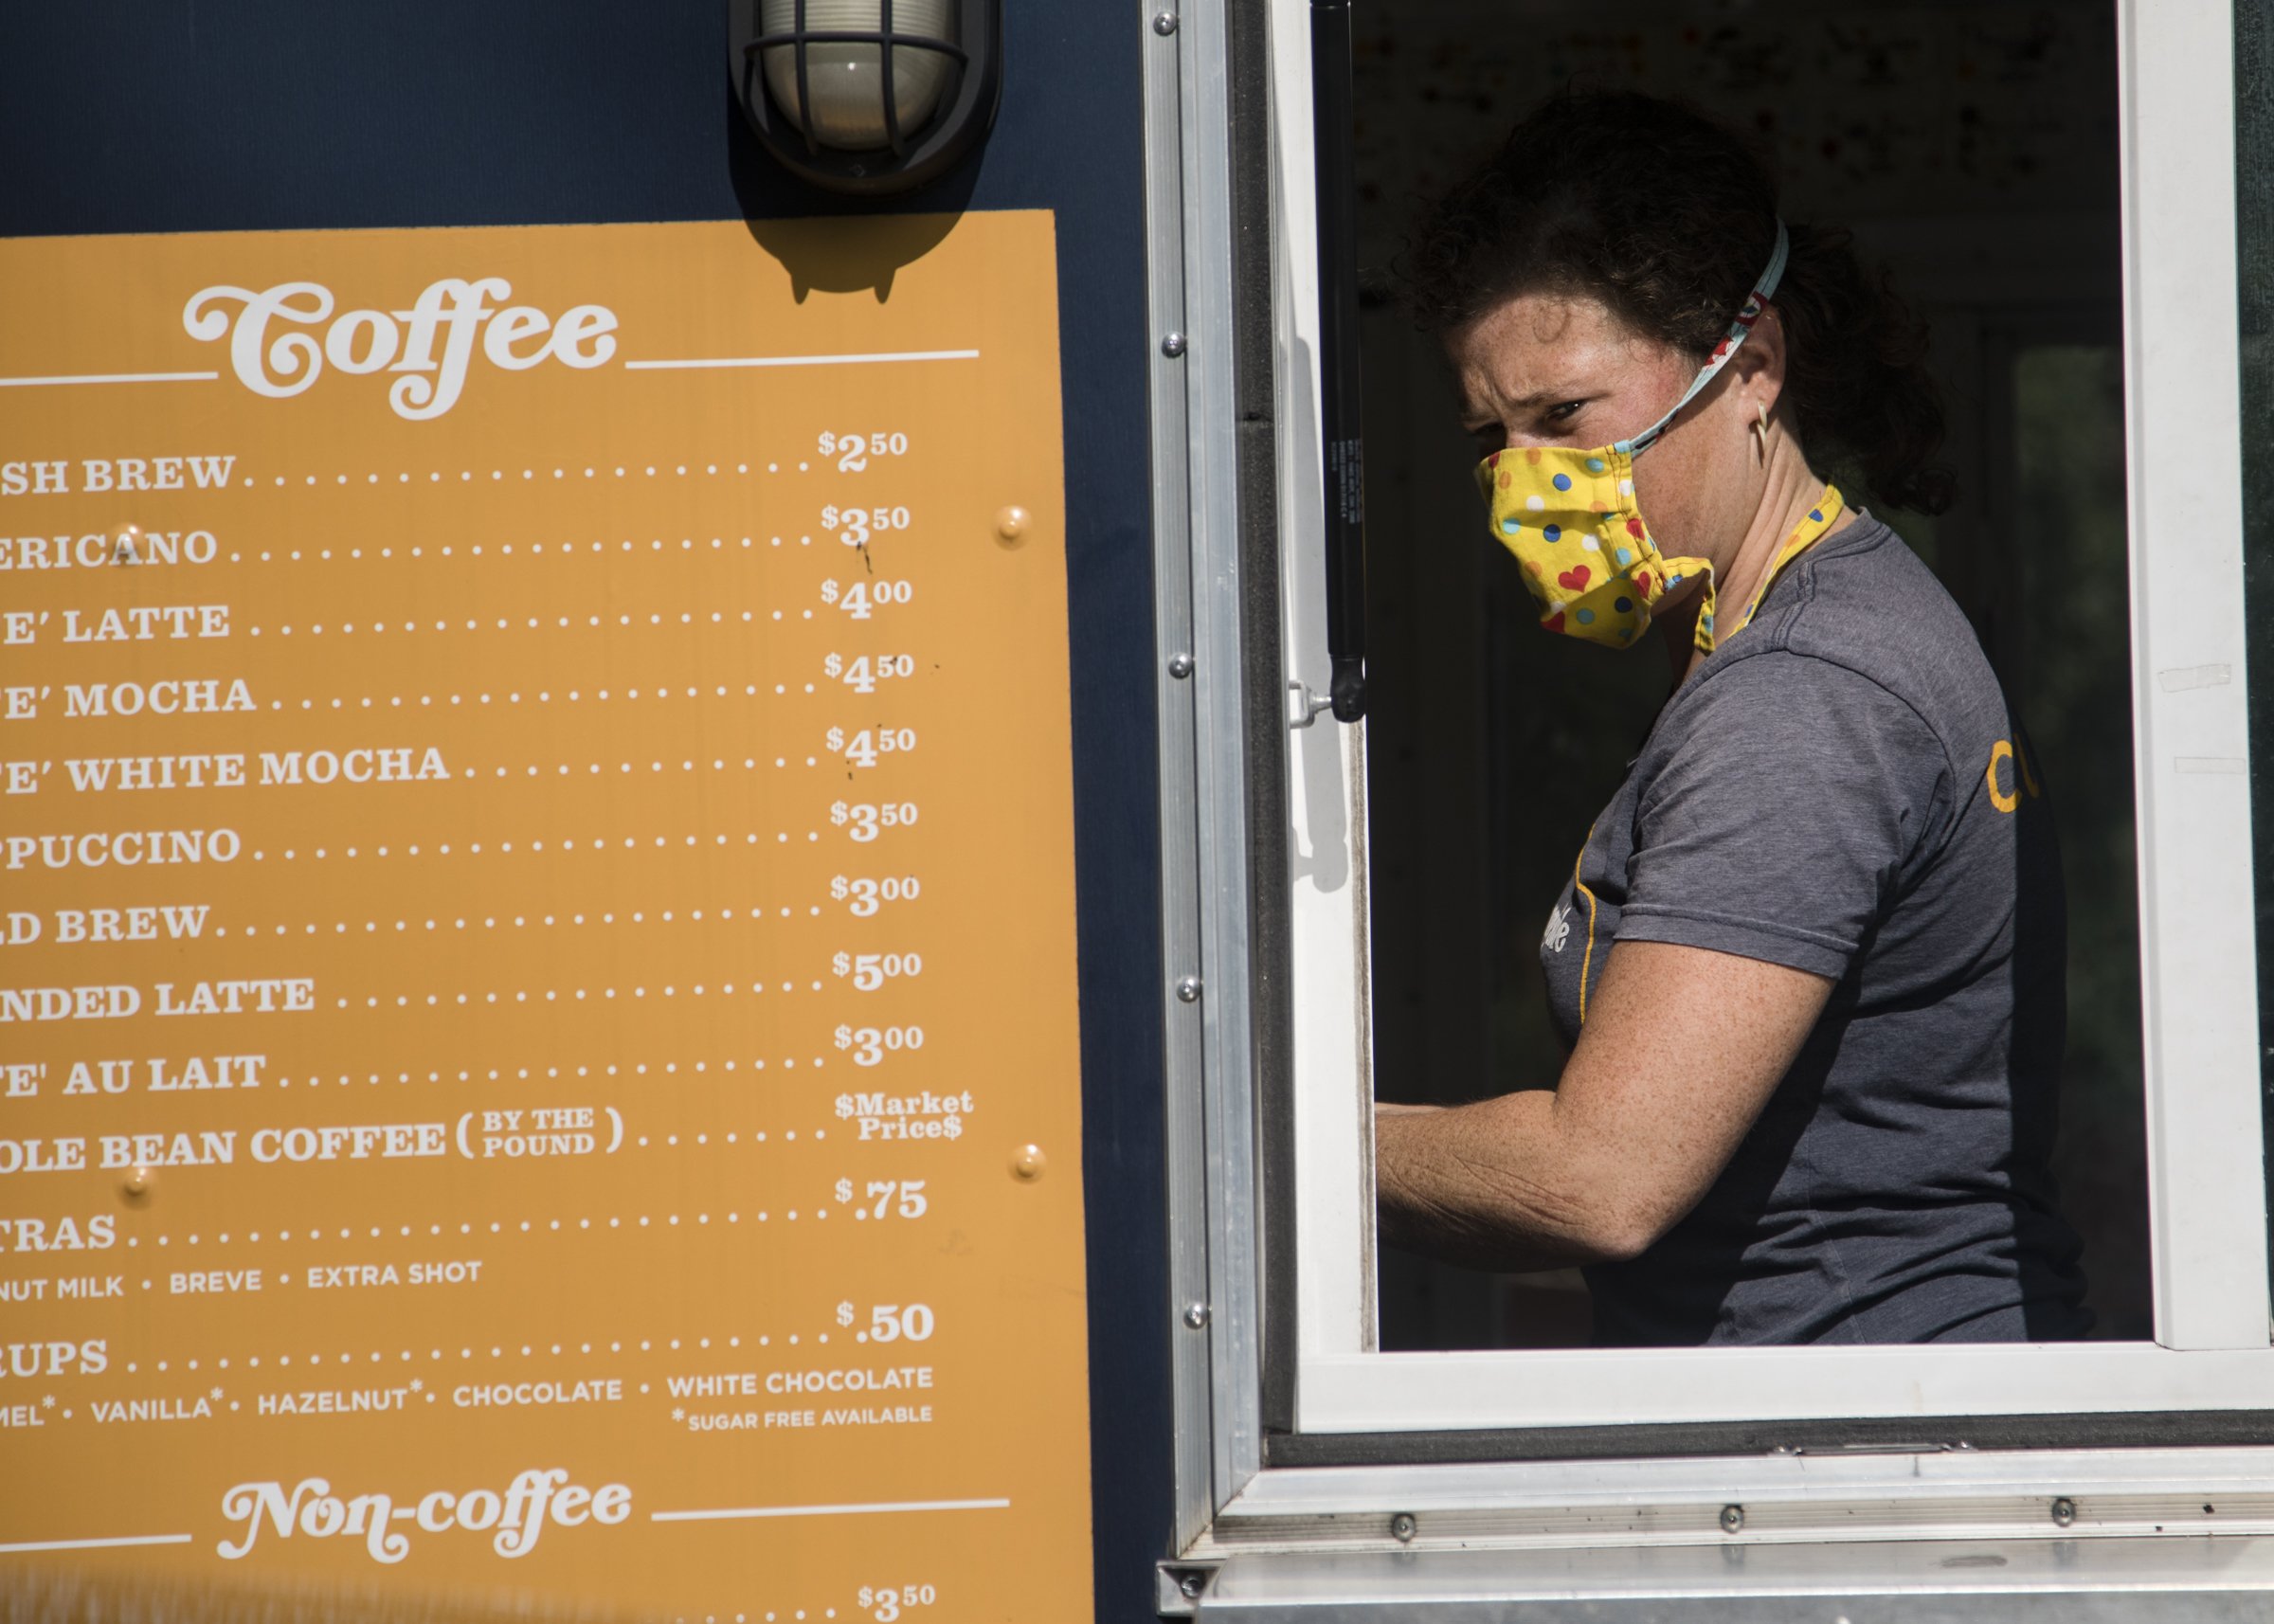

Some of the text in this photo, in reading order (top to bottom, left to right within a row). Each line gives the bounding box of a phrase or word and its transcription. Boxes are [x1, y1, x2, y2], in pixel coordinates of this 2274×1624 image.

[183, 278, 618, 420] Coffee
[3, 456, 235, 495] SH BREW
[63, 605, 229, 641] LATTE
[65, 679, 257, 716] MOCHA
[0, 748, 450, 793] E' WHITE MOCHA
[0, 829, 240, 869] PUCCINO
[0, 906, 209, 945] D BREW
[0, 979, 314, 1021] NDED LATTE
[0, 1056, 265, 1096] E' AU LAIT
[834, 1092, 974, 1120] $Market
[99, 1134, 236, 1169] BEAN
[251, 1124, 445, 1162] COFFEE
[59, 1276, 122, 1298] MILK
[171, 1271, 261, 1293] BREVE
[308, 1265, 399, 1288] EXTRA
[409, 1261, 481, 1284] SHOT
[454, 1380, 622, 1406] CHOCOLATE
[667, 1374, 757, 1397] WHITE
[766, 1367, 932, 1393] CHOCOLATE
[765, 1410, 815, 1427] FREE
[822, 1406, 931, 1425] AVAILABLE
[218, 1468, 632, 1563] Non-coffee
